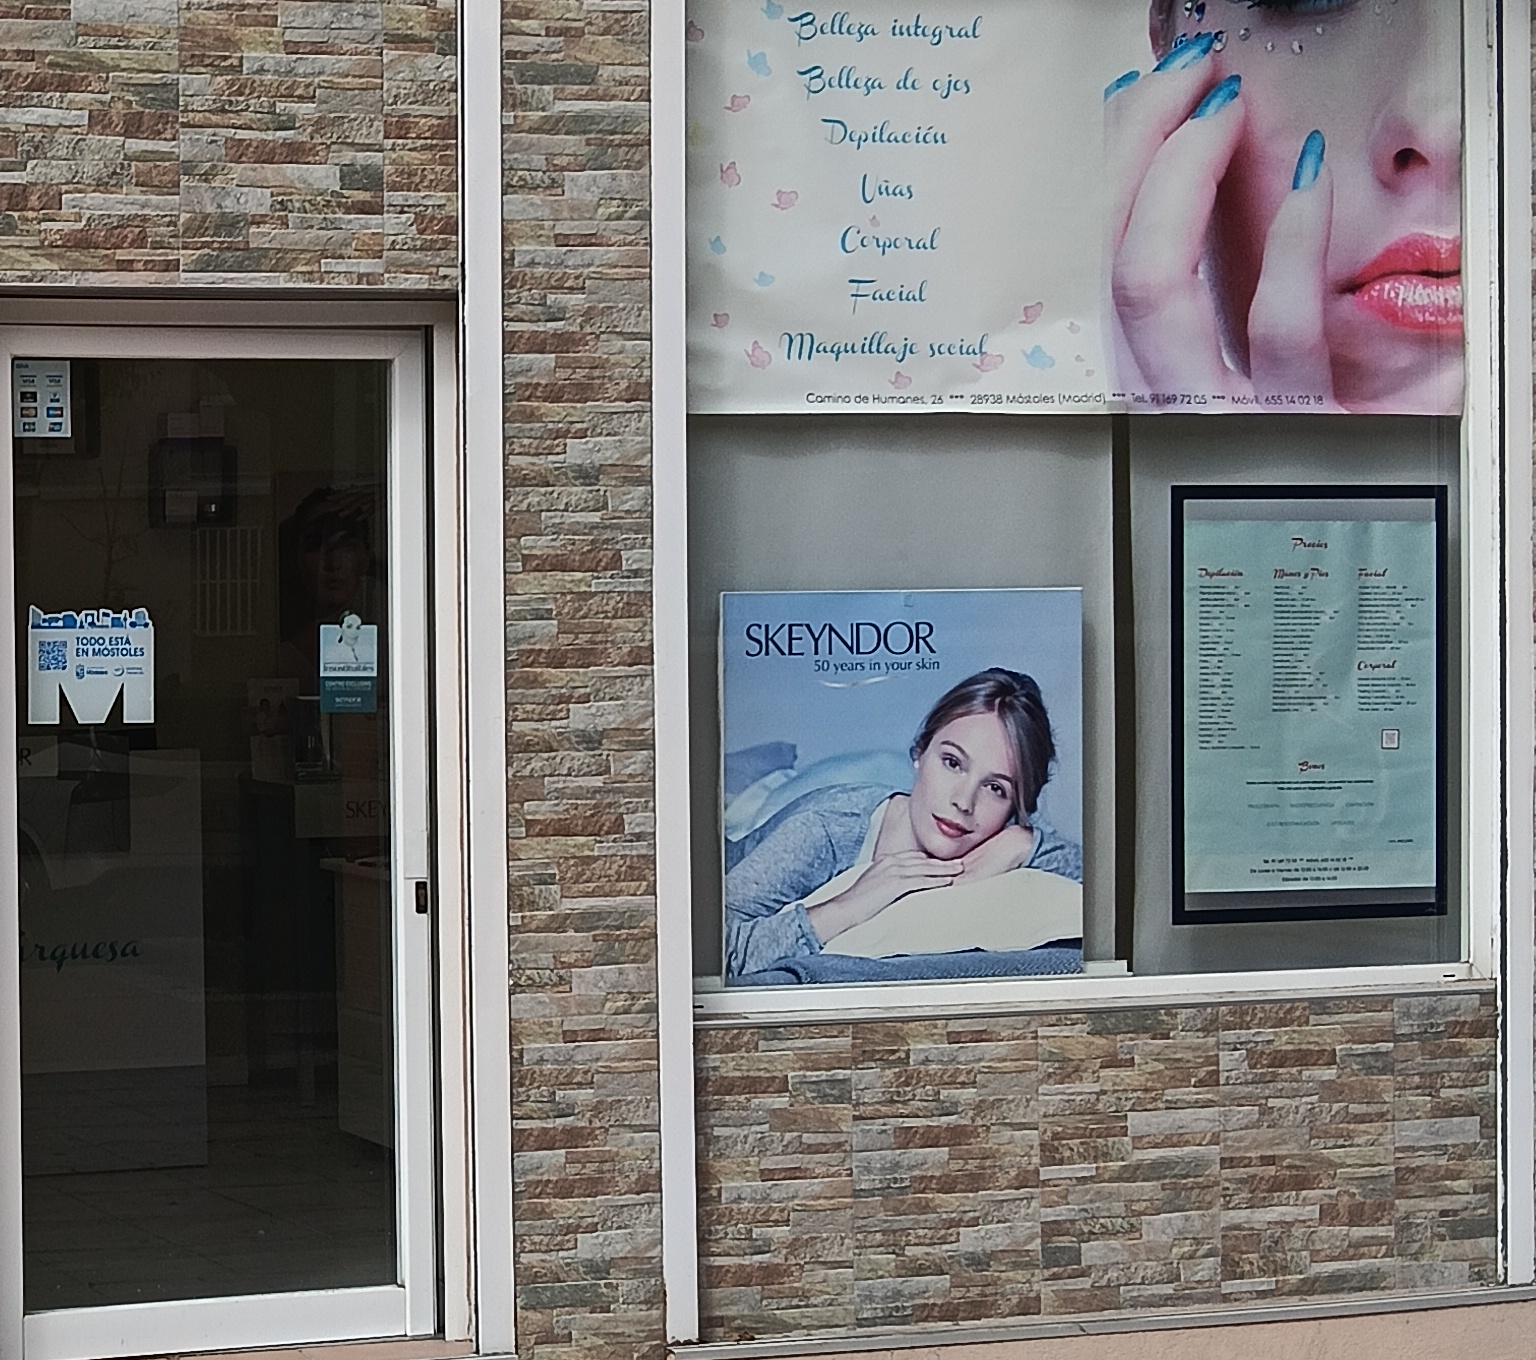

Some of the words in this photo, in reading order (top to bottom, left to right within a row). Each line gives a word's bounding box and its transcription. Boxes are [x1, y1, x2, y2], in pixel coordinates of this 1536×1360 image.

[787, 11, 880, 48] Belleza
[890, 14, 985, 45] integral
[796, 65, 888, 100] Belleza
[895, 66, 922, 90] de
[931, 72, 972, 99] ojos
[820, 118, 949, 151] Depilación
[861, 173, 914, 204] Uñas
[840, 225, 942, 256] Corporal
[847, 278, 928, 315] Facial
[778, 331, 922, 363] Maquillaje
[928, 333, 990, 358] social
[806, 392, 852, 404] Camino
[854, 393, 869, 404] de
[970, 394, 1003, 405] 28938
[1005, 392, 1055, 404] Móstoles
[1058, 392, 1107, 405] (Madrid)
[1179, 394, 1193, 404] 72
[1264, 394, 1283, 405] 655
[1285, 395, 1296, 405] 14
[1298, 395, 1311, 405] 02
[1313, 395, 1324, 405] 18
[75, 636, 106, 647] TODO
[108, 635, 132, 647] ESTÁ
[75, 647, 89, 658] EN
[91, 645, 145, 658] MÓSTOLES
[744, 621, 937, 657] SKEYNDOR
[813, 659, 830, 673] 50
[833, 660, 866, 674] years
[868, 659, 881, 671] in
[883, 661, 913, 674] your
[915, 658, 941, 671] skin
[20, 938, 145, 973] rquesa
